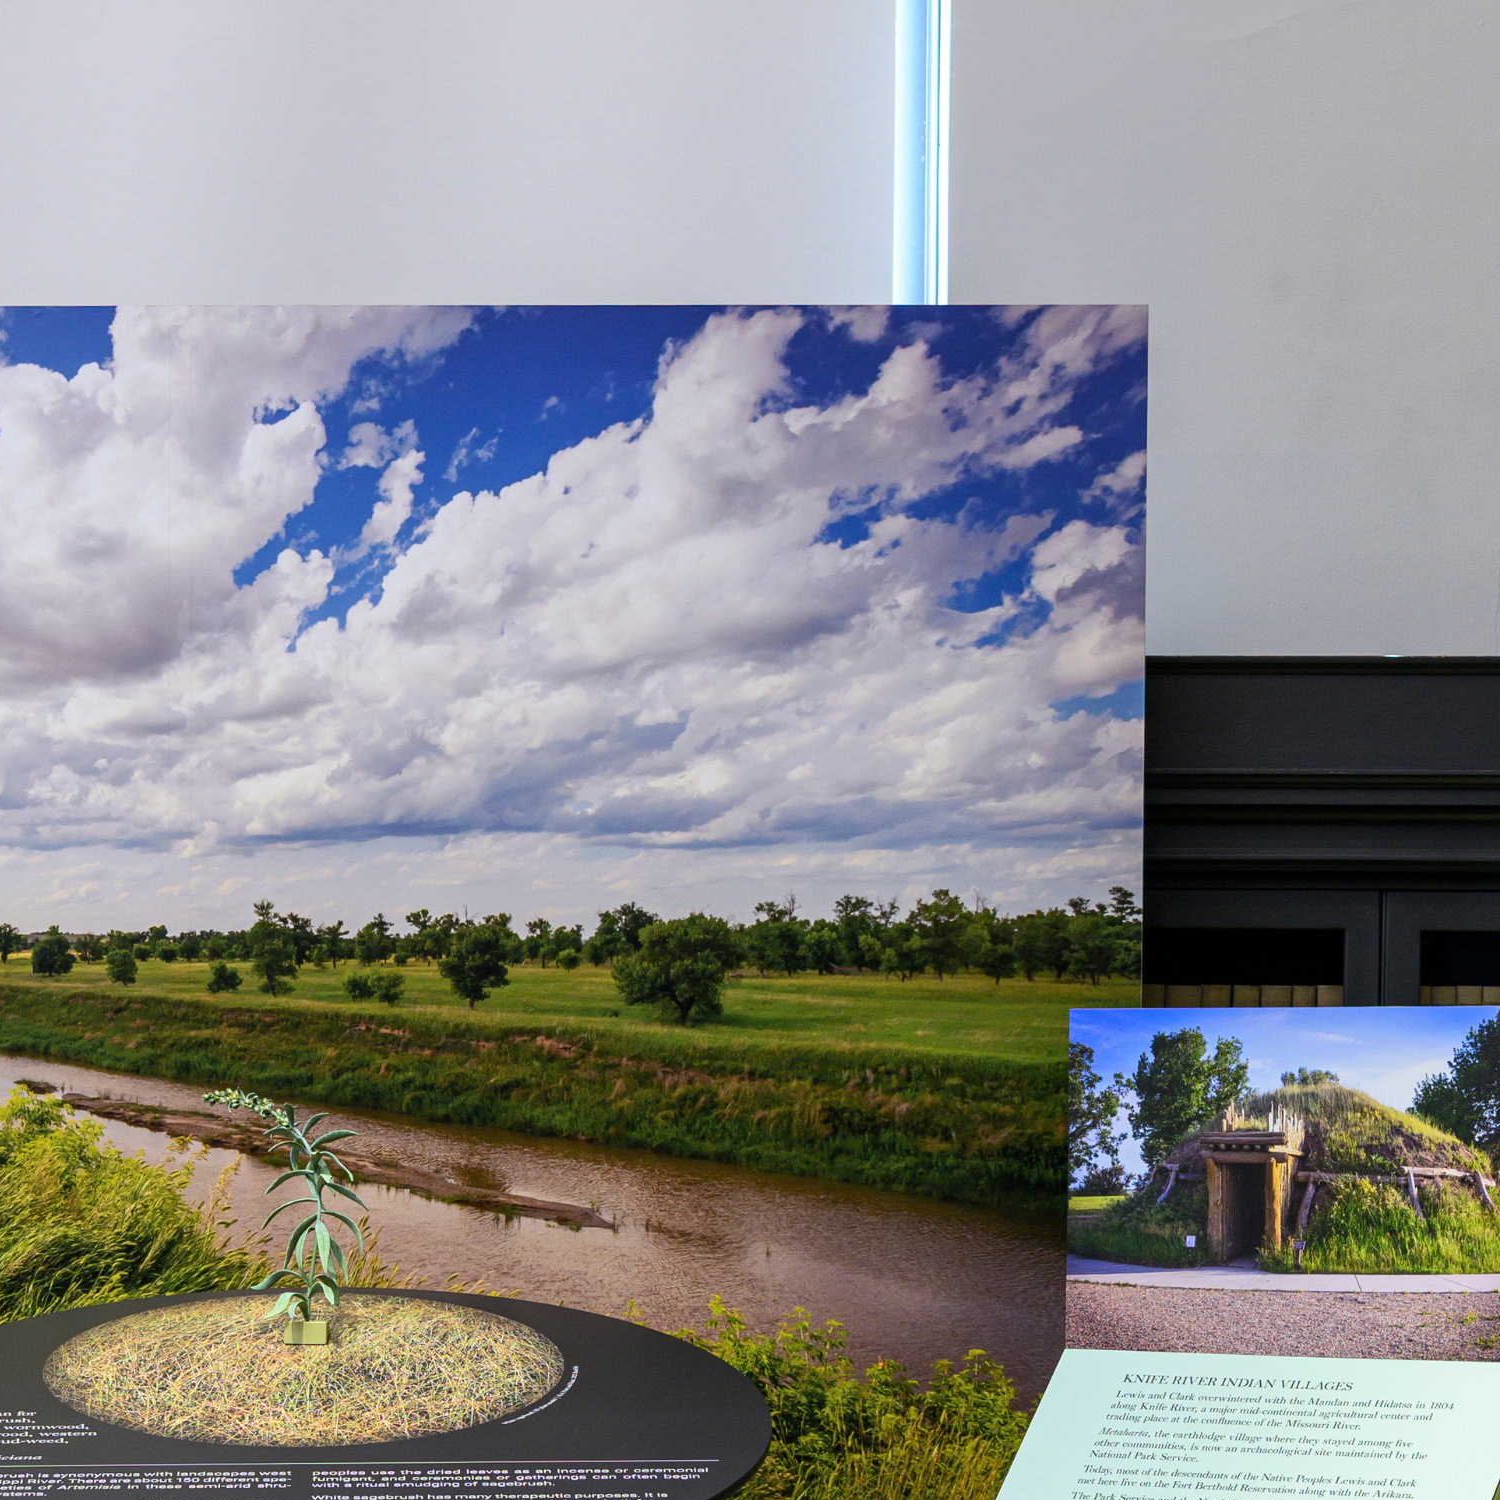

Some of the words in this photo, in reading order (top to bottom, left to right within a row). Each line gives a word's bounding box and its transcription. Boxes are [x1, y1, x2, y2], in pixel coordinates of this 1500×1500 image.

[1123, 1374, 1169, 1384] KNIFE
[1172, 1376, 1218, 1386] RIVER
[1221, 1377, 1276, 1388] INDIAN
[1281, 1380, 1353, 1391] VILLAGES
[1116, 1390, 1145, 1398] Lewis
[1169, 1392, 1195, 1401] Clark
[1198, 1394, 1263, 1403] overwintered
[1265, 1396, 1286, 1404] with
[1289, 1397, 1305, 1405] the
[1308, 1397, 1349, 1406] Mandan
[1352, 1399, 1372, 1407] and
[1374, 1400, 1413, 1408] Hidatsa
[1415, 1401, 1426, 1409] in
[1430, 1402, 1454, 1410] 1804
[1110, 1401, 1137, 1412] along
[1140, 1402, 1167, 1411] Knife
[1170, 1403, 1197, 1413] River,
[1209, 1405, 1238, 1416] major
[1239, 1407, 1317, 1417] mid-continental
[1318, 1410, 1379, 1419] agricultural
[1413, 1413, 1433, 1421] and
